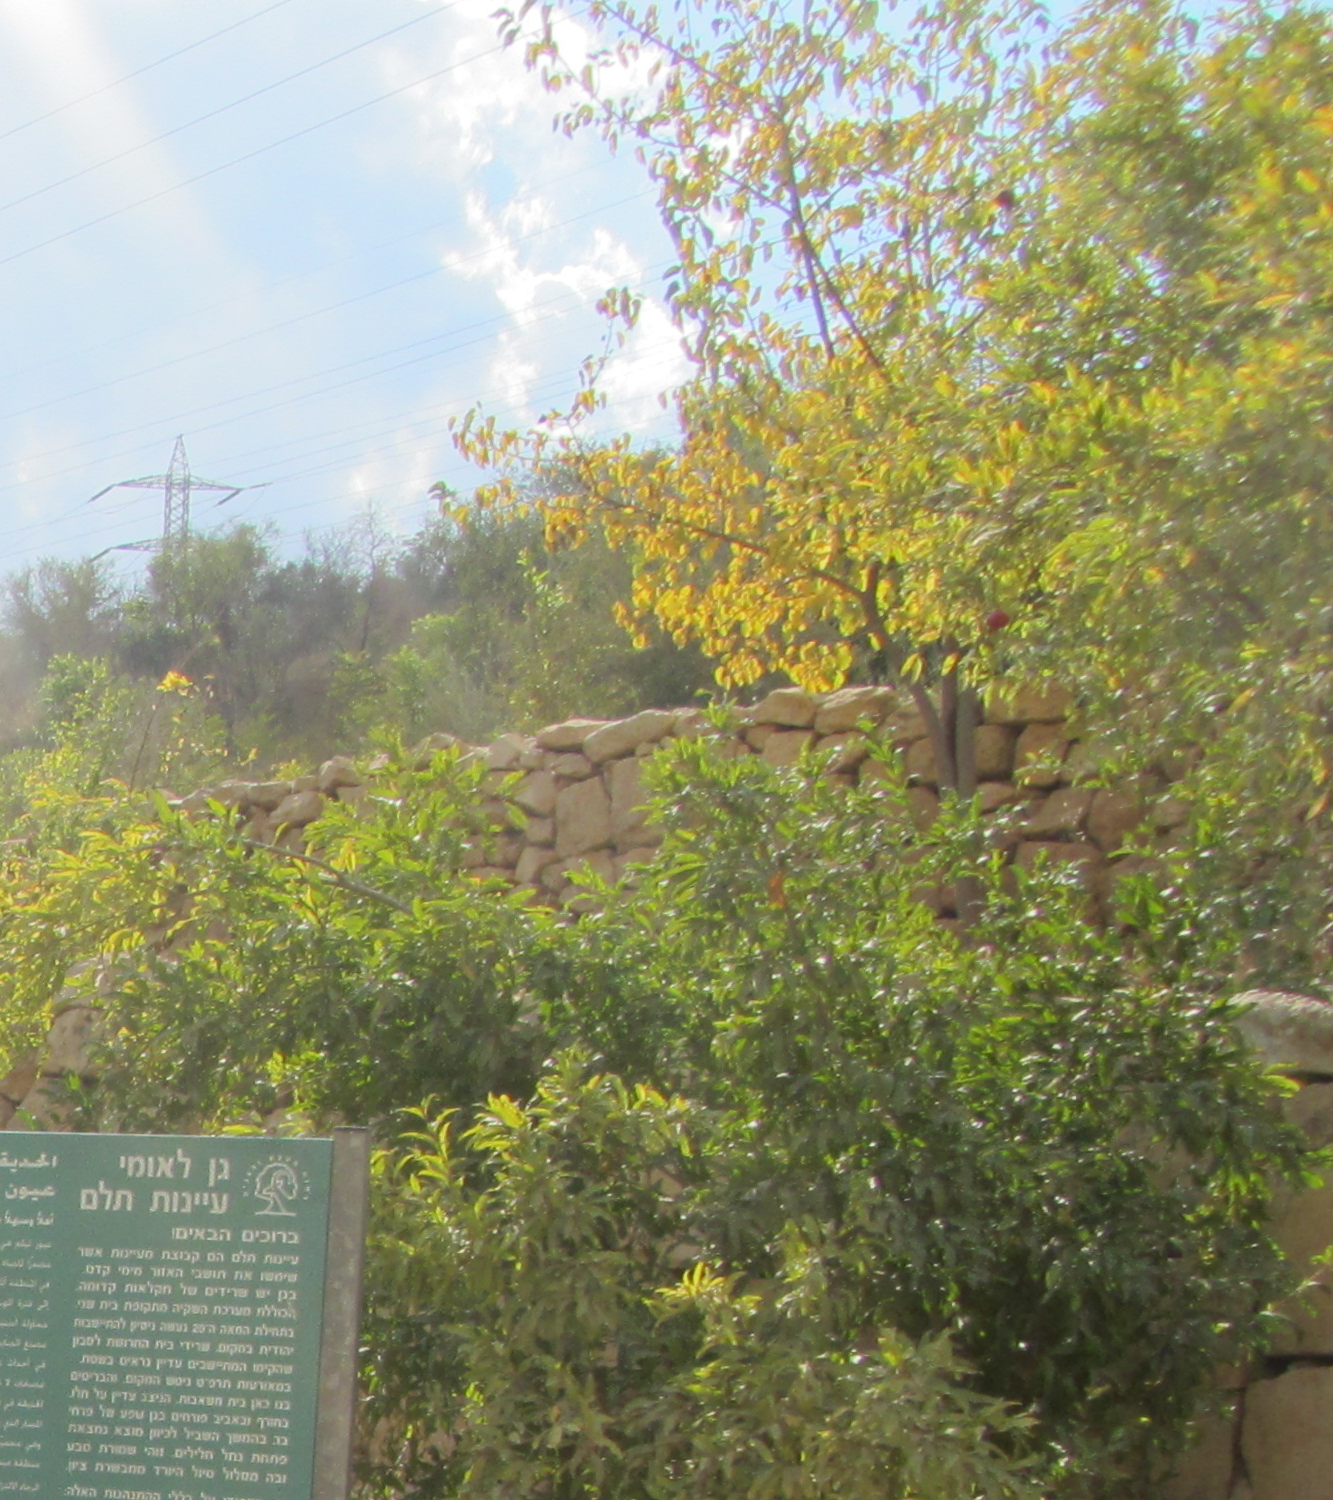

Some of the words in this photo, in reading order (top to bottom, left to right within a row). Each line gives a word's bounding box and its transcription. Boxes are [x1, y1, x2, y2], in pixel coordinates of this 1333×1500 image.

[119, 1147, 191, 1178] לאומי
[208, 1158, 230, 1186] גן
[5, 1184, 55, 1201] عيون
[79, 1180, 134, 1211] תלם
[150, 1190, 228, 1214] עיינות
[241, 1229, 300, 1243] ברוכים
